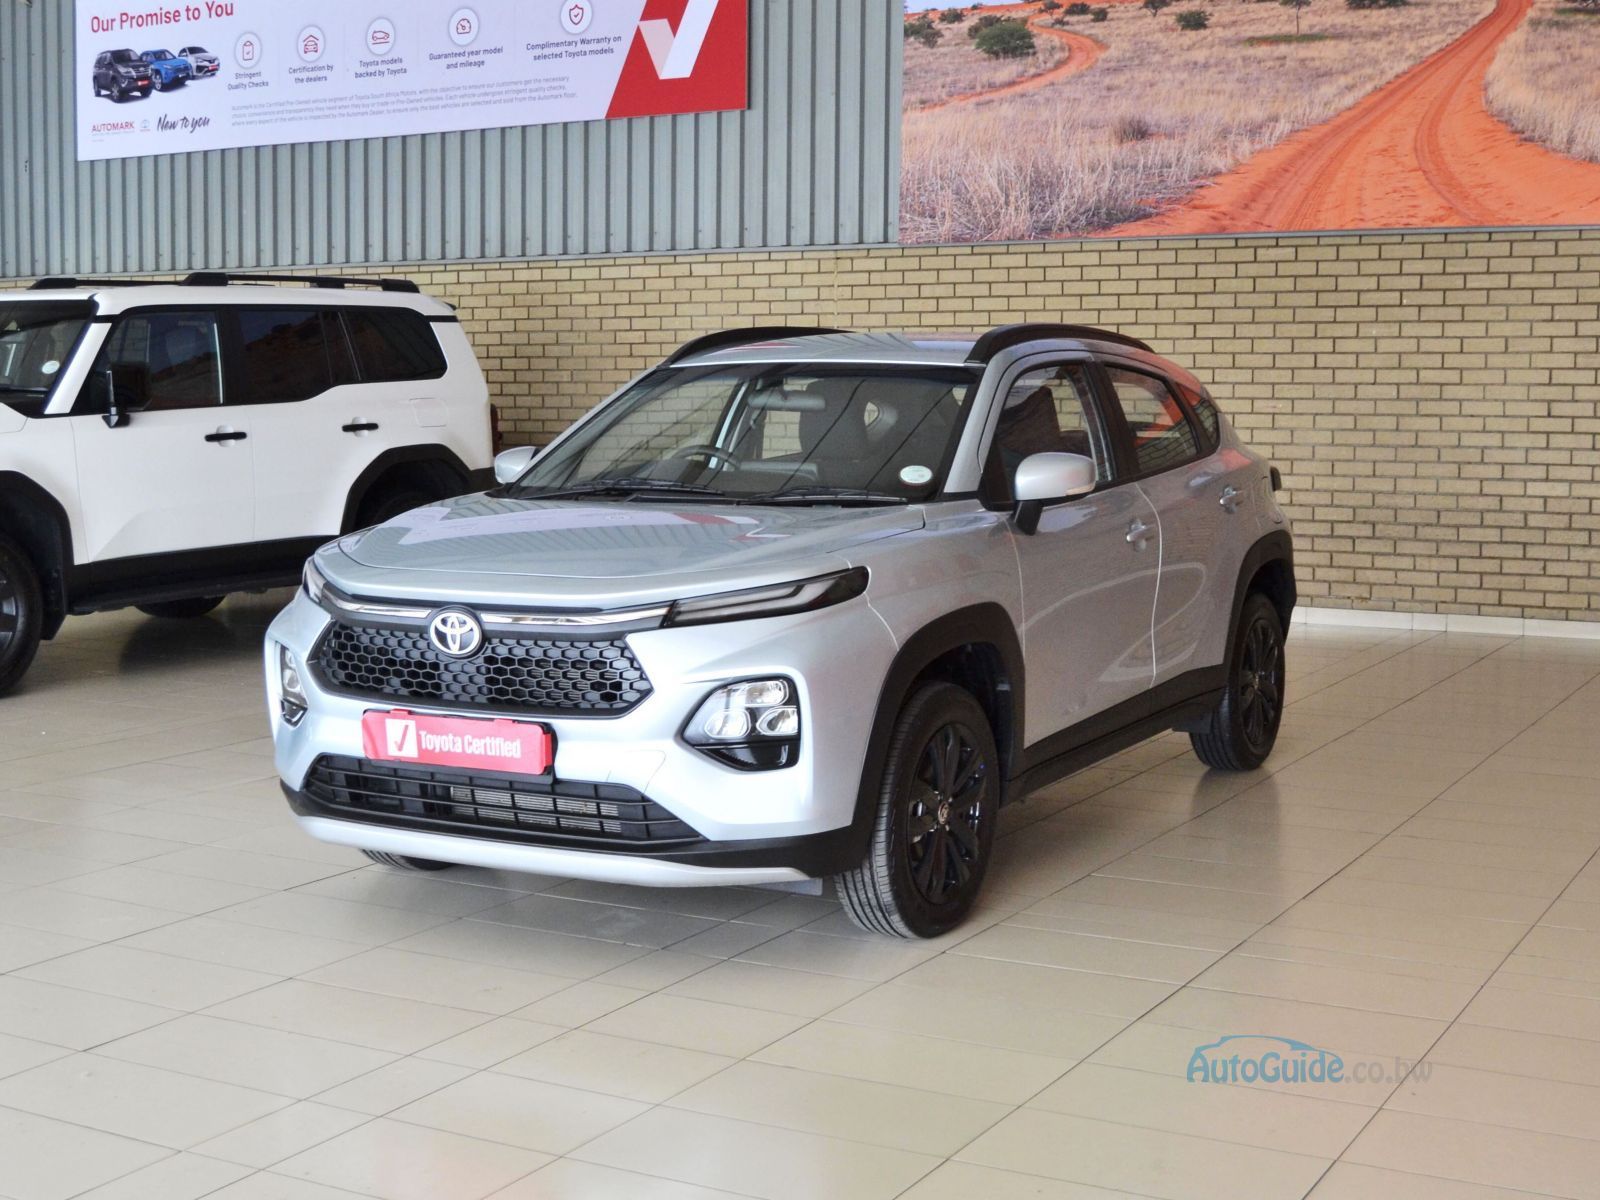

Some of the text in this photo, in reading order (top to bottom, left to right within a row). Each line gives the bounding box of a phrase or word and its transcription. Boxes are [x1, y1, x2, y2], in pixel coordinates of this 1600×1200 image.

[91, 1, 234, 33] Our Promise to You
[526, 34, 622, 51] Complimentary Warranty on
[429, 46, 504, 61] Guaranteed year model
[533, 46, 614, 61] selected Toyota models
[288, 63, 334, 75] Certification by
[359, 57, 403, 70] Toyota models
[446, 58, 485, 70] and mileage
[235, 71, 262, 81] Stringent
[294, 74, 328, 84] the dealers
[354, 66, 408, 79] backed by Toyota
[227, 80, 269, 92] Quality Checks
[92, 121, 135, 132] AUTOMARK
[157, 113, 211, 134] New to you
[419, 731, 522, 758] Toyota Certified
